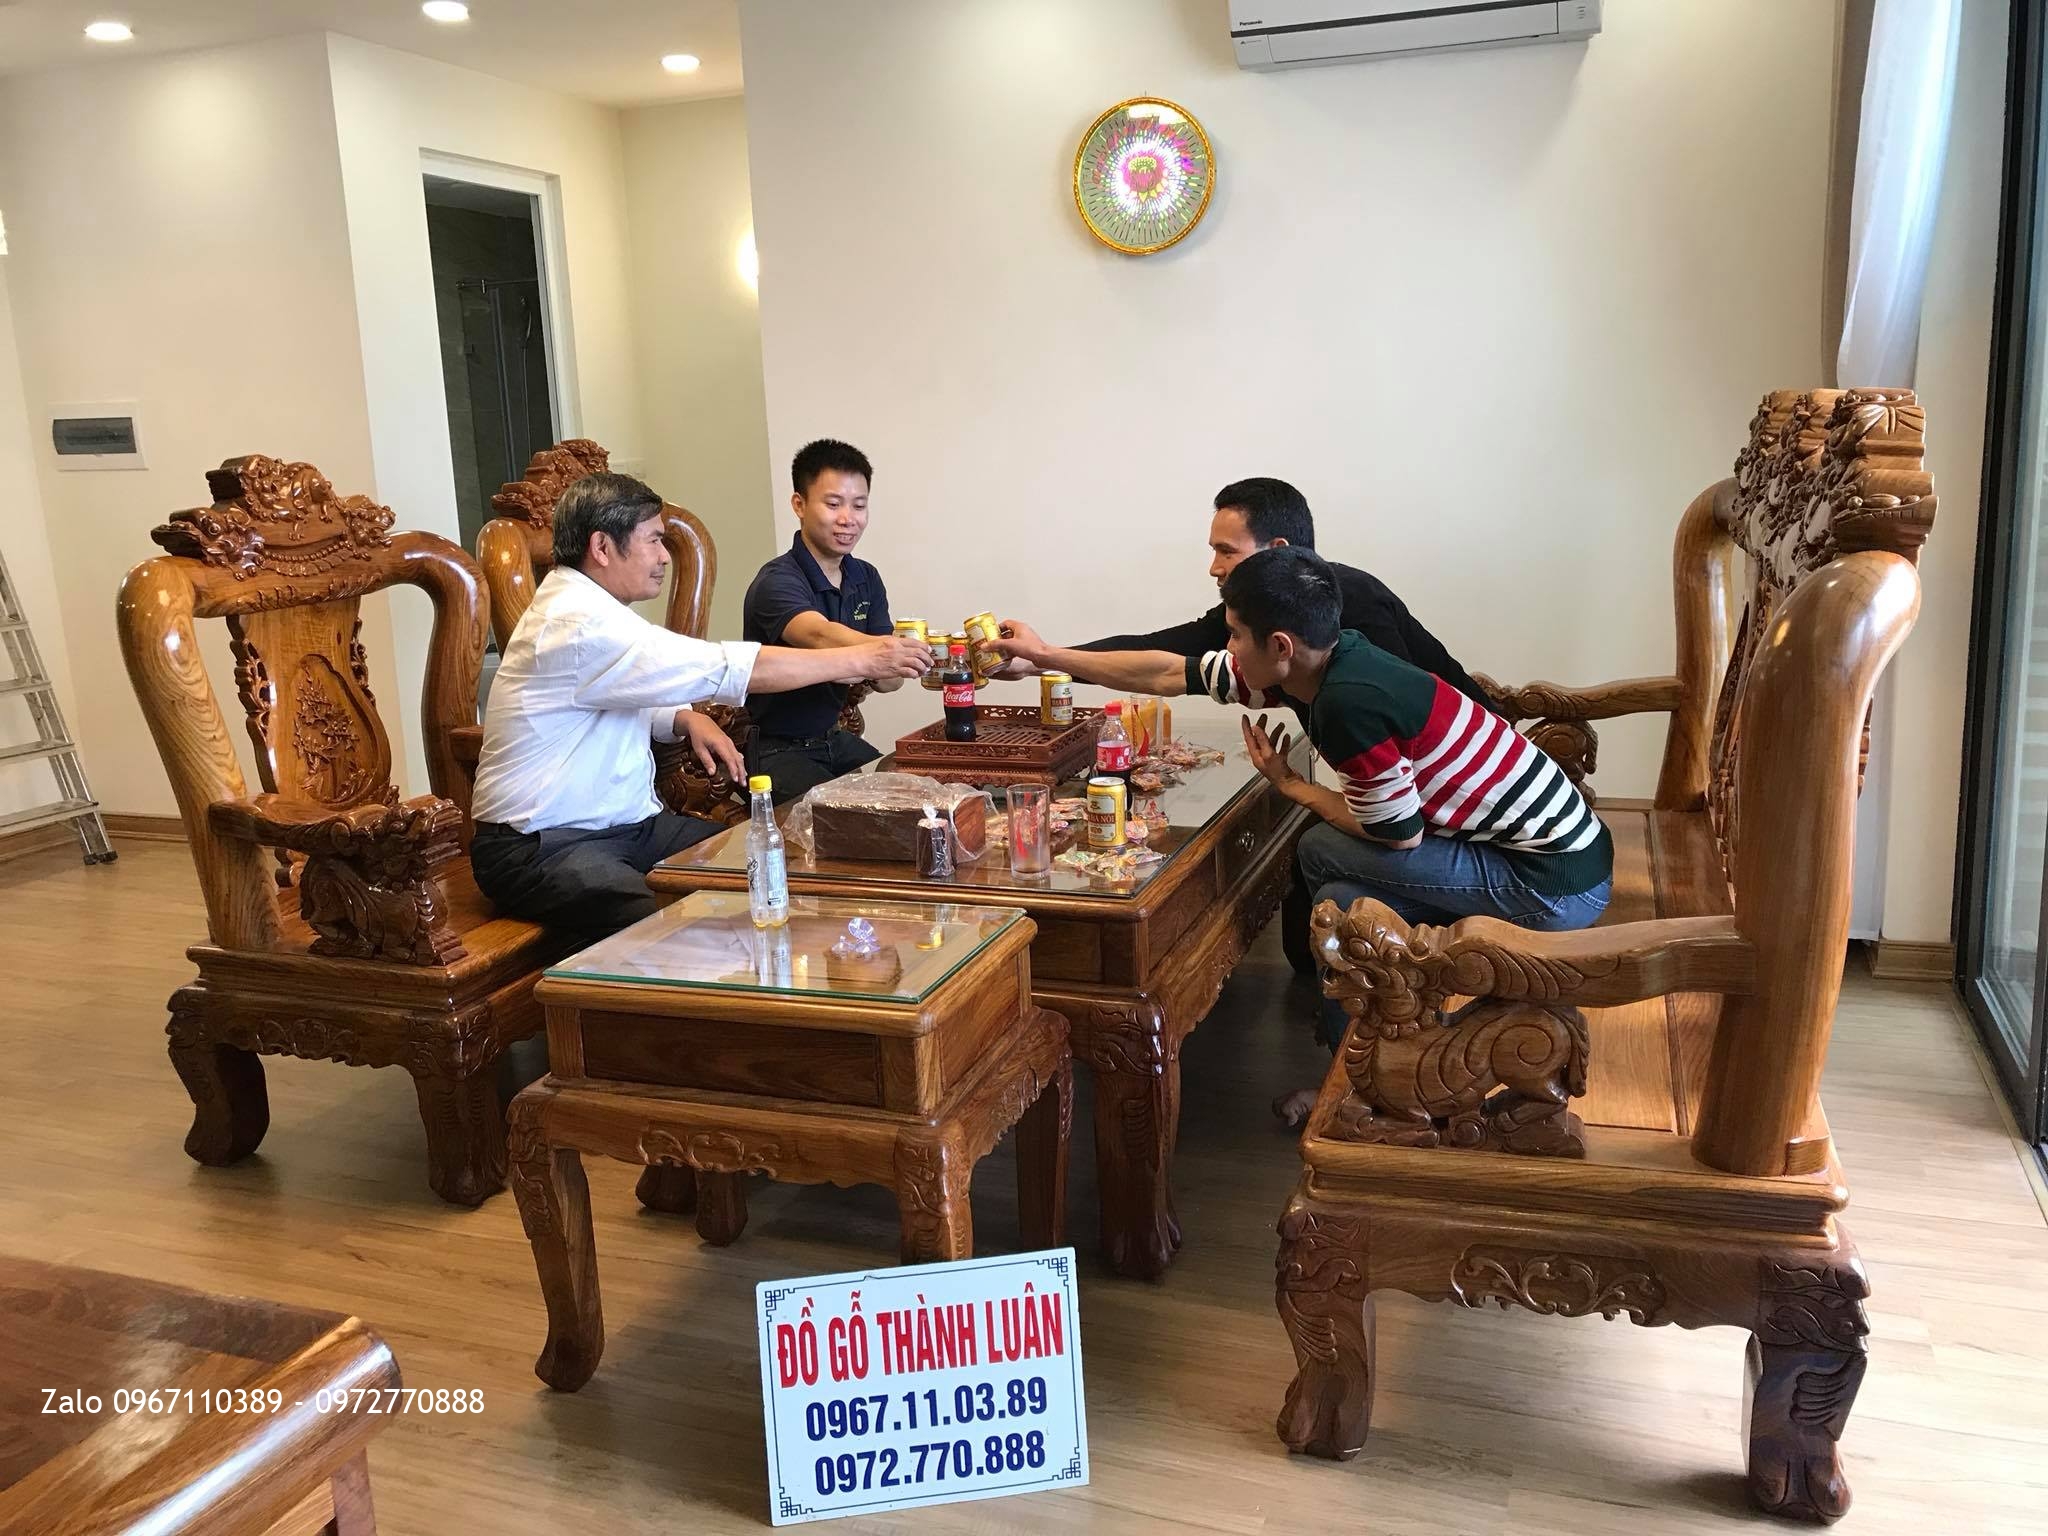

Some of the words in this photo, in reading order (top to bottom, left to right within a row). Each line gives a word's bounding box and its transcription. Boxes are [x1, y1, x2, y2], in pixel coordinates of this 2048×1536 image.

[777, 1297, 820, 1389] ĐỒ
[828, 1290, 869, 1382] GỖ
[876, 1293, 978, 1375] THÀNH
[986, 1282, 1064, 1363] LUÂN
[806, 1376, 1048, 1441] 0967.11.03.89
[815, 1430, 1046, 1495] 0972.770.888
